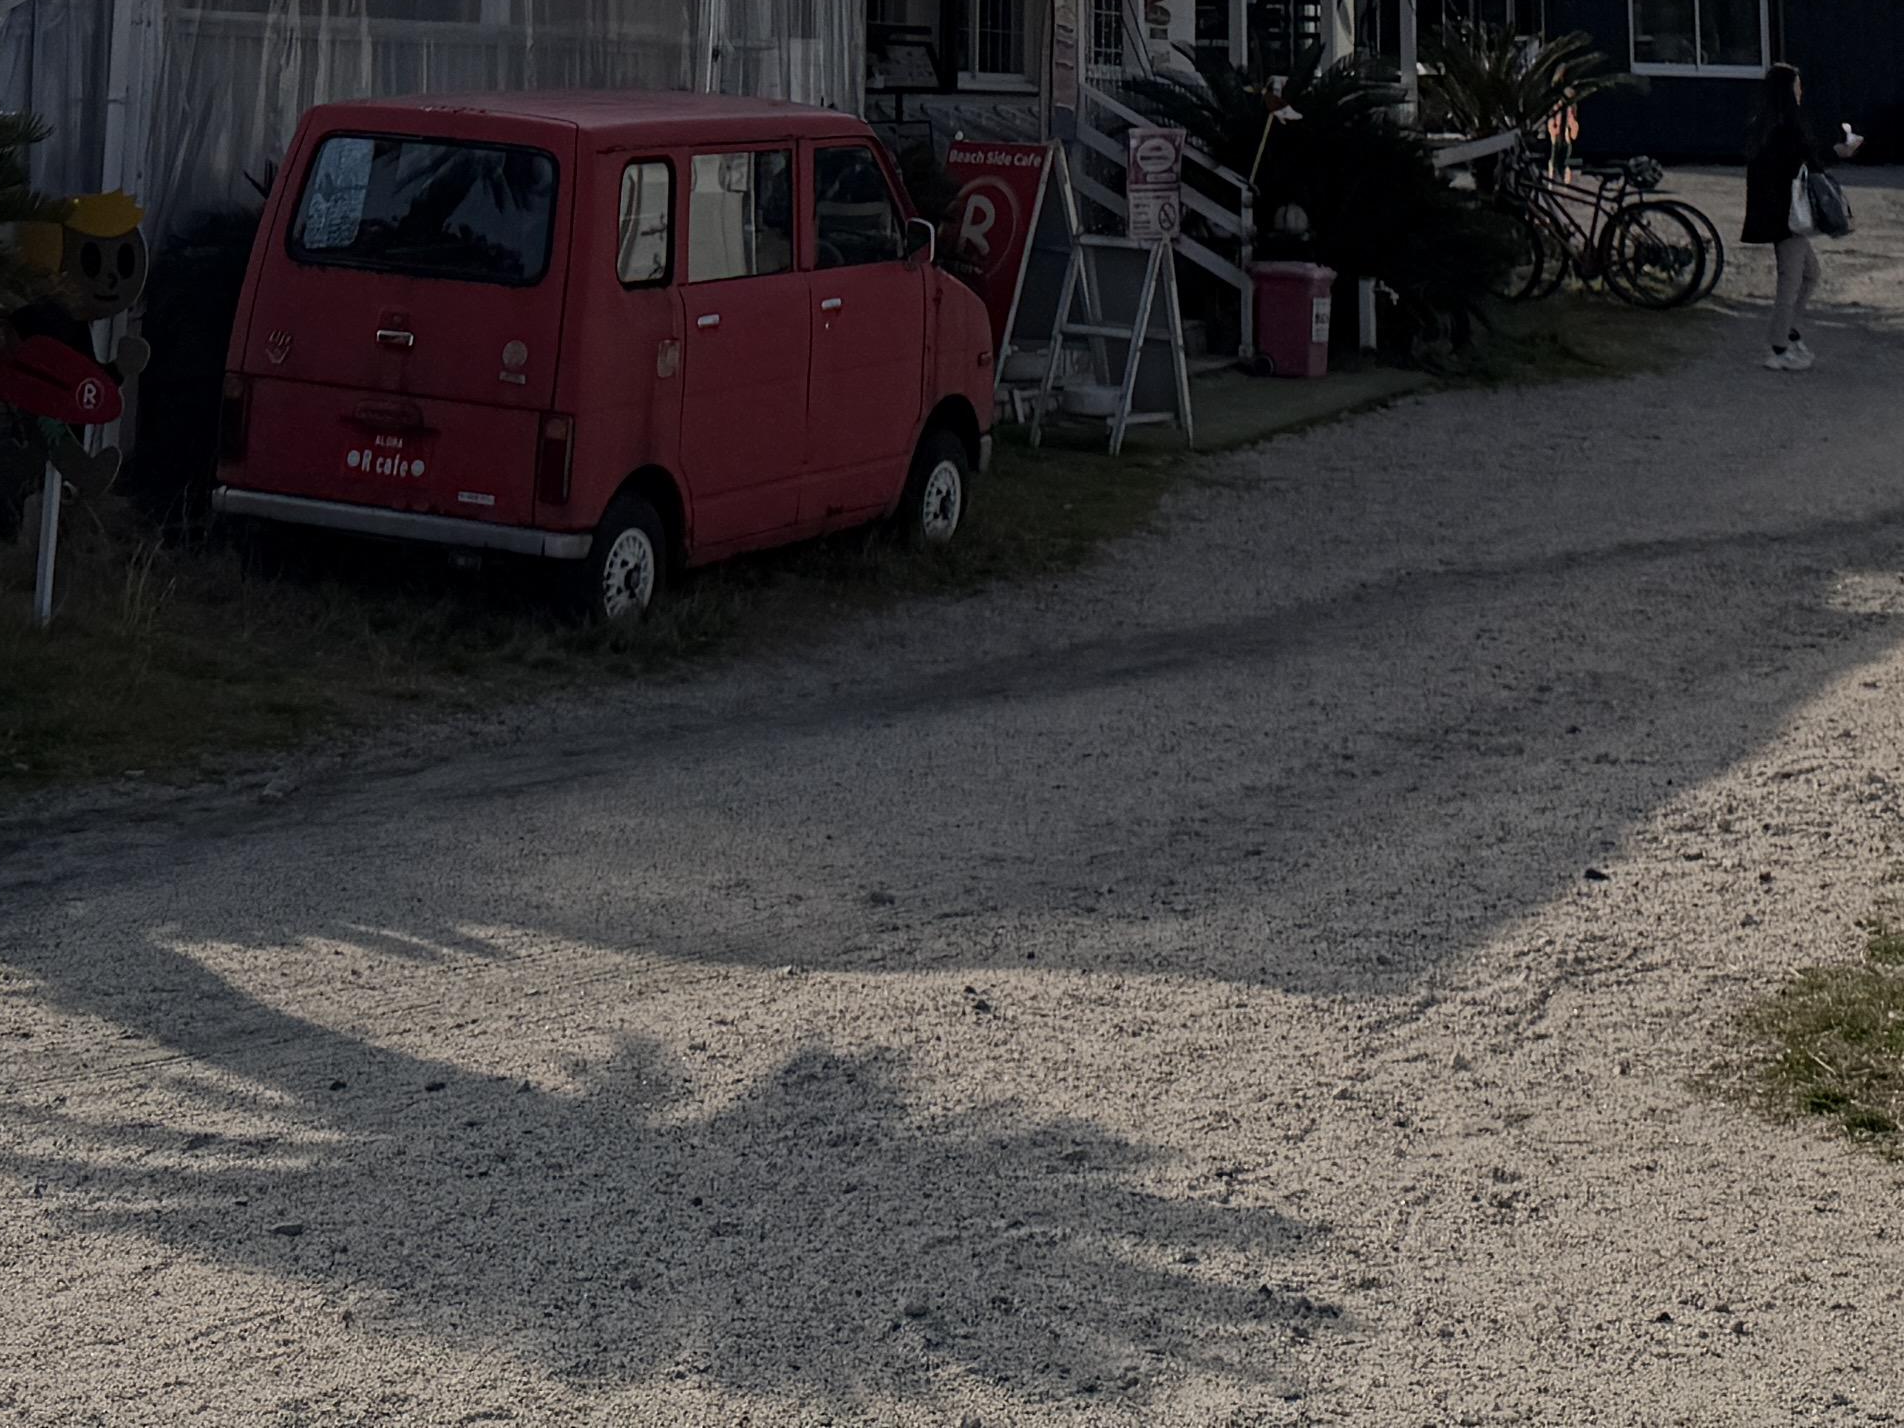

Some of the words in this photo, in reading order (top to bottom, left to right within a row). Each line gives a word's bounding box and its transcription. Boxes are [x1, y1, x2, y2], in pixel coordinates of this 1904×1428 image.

[949, 148, 985, 165] Beach
[985, 149, 1012, 167] Side
[1013, 152, 1043, 169] Cafe
[958, 193, 996, 256] R
[361, 448, 373, 473] R
[375, 453, 409, 478] cafe
